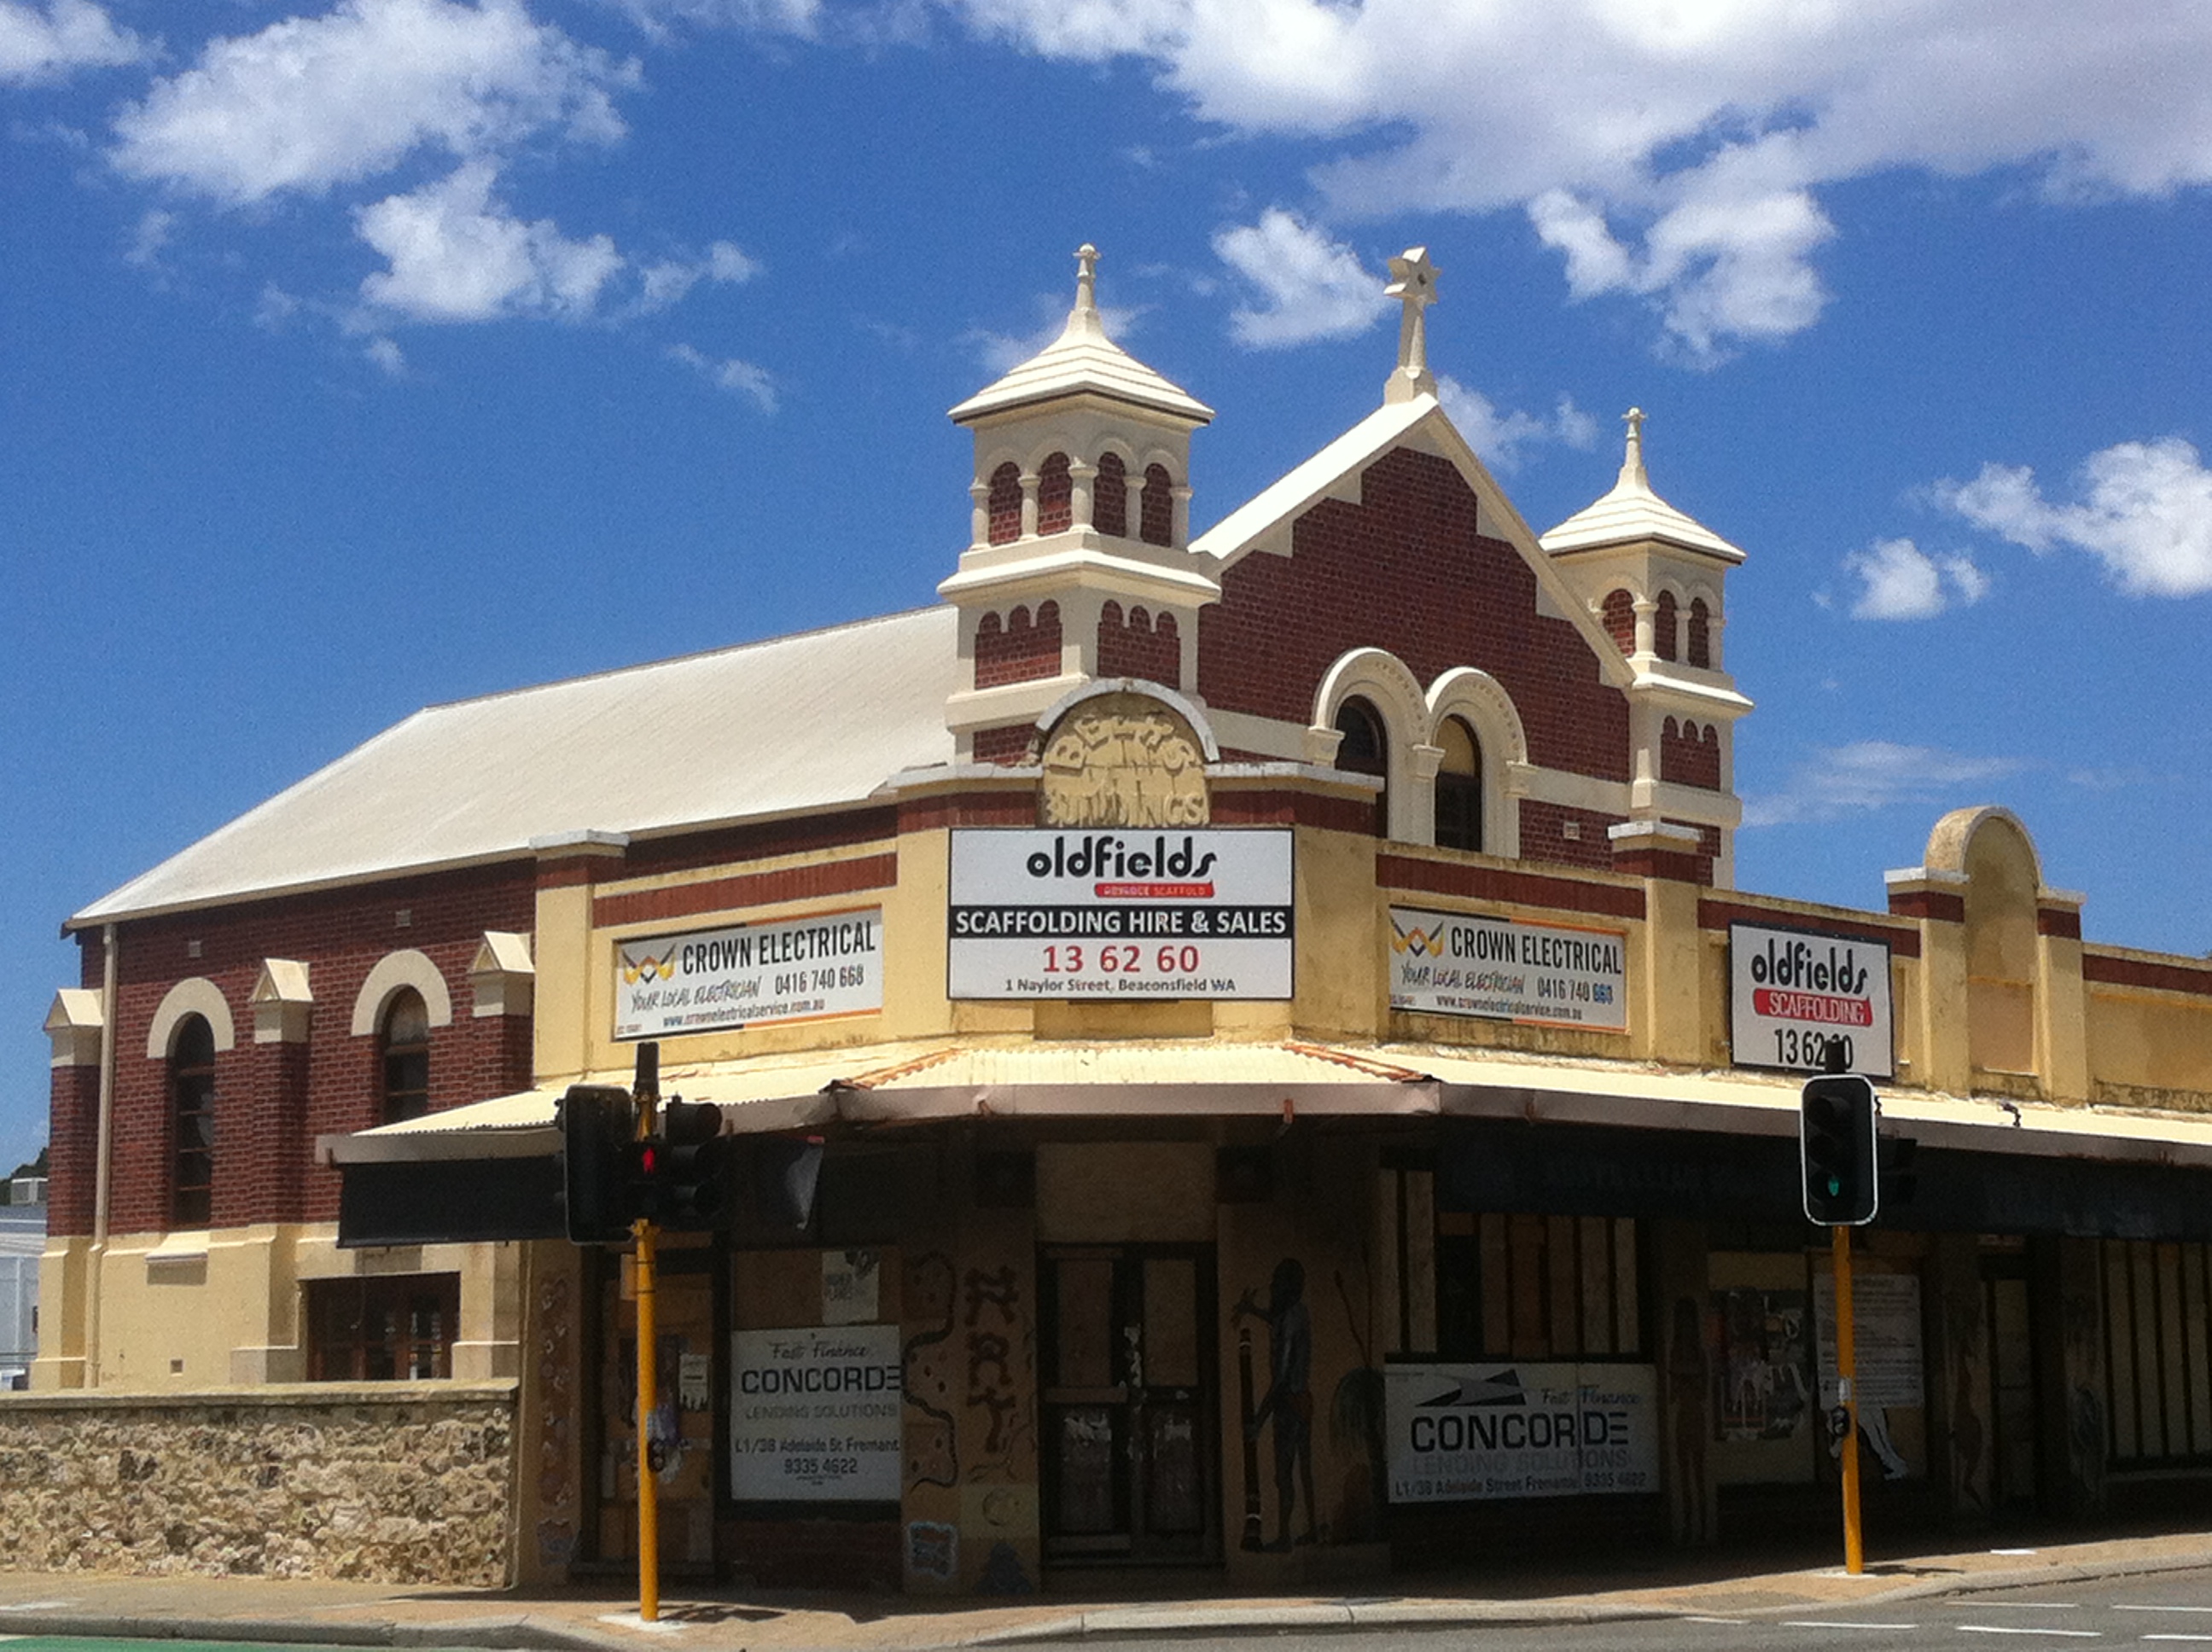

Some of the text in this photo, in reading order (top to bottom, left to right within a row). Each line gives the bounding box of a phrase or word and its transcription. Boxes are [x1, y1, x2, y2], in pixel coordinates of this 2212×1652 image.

[1026, 835, 1218, 878] oldfields
[1154, 885, 1206, 896] SCAFFOLD
[956, 910, 1287, 934] SCAFFOLDING HIRE & SALES
[683, 920, 876, 975] CROWN ELECTRICAL
[1043, 945, 1199, 973] 13 62 60
[1451, 927, 1622, 974] CROWN ELECTRICAL
[1400, 962, 1526, 995] YOUR LOCAL ELECTRICIAN
[1751, 938, 1868, 994] oldfields
[632, 975, 762, 1013] YOUR LOCAL ELECTRICIAN
[775, 971, 807, 996] 0416
[810, 967, 835, 992] 740
[1006, 979, 1013, 991] 1
[1017, 978, 1063, 993] Naylor
[1118, 978, 1207, 992] Beaconsfield
[1211, 979, 1236, 992] WA
[1536, 975, 1566, 1001] 0416
[1569, 979, 1590, 1003] 740
[1768, 992, 1866, 1024] SCAFFOLDING
[741, 1366, 901, 1394] CONCORDE
[813, 1403, 897, 1420] SOLUTIONS
[1411, 1411, 1629, 1452] CONCORDE
